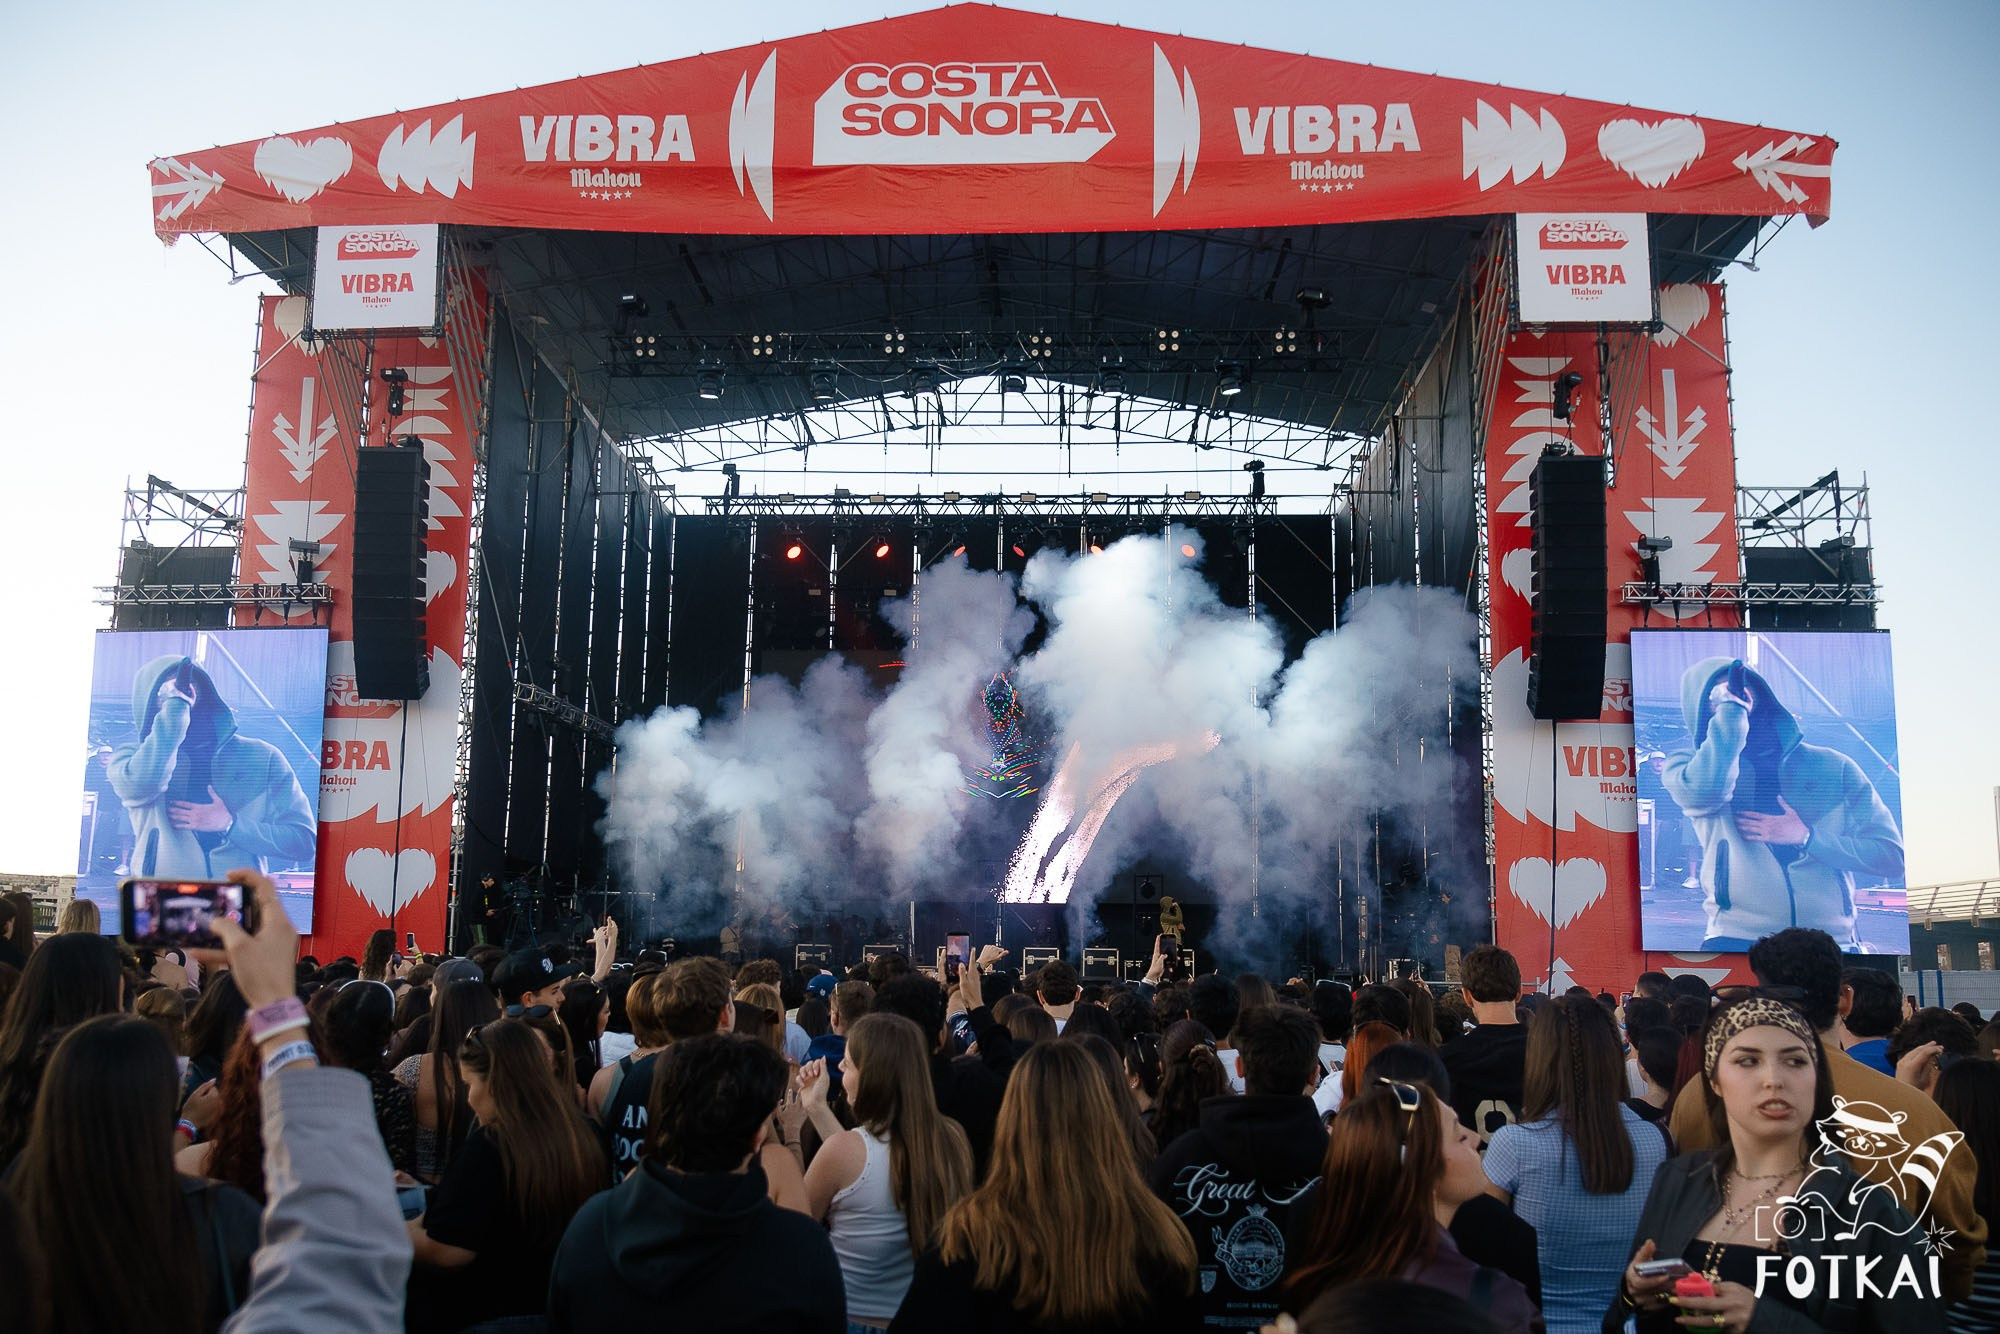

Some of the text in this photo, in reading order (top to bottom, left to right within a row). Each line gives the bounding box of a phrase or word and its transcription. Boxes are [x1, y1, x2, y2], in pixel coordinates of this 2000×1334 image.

[844, 65, 1056, 98] COSTA
[841, 100, 1112, 136] SONORA
[519, 114, 696, 161] VIBRA
[1233, 103, 1421, 155] VIBRA
[570, 168, 642, 188] Mahou
[1289, 160, 1365, 180] Mahou
[1546, 220, 1612, 231] COSTA
[346, 230, 405, 242] COSTA
[1546, 230, 1628, 243] SONORA
[344, 240, 420, 253] SONORA
[341, 272, 414, 294] VIBRA
[1545, 264, 1627, 285] VIBRA
[362, 296, 392, 304] Mahou
[1571, 288, 1603, 296] Mahou
[322, 740, 391, 771] BRA
[1562, 745, 1636, 778] VIB
[1599, 782, 1637, 794] Maho
